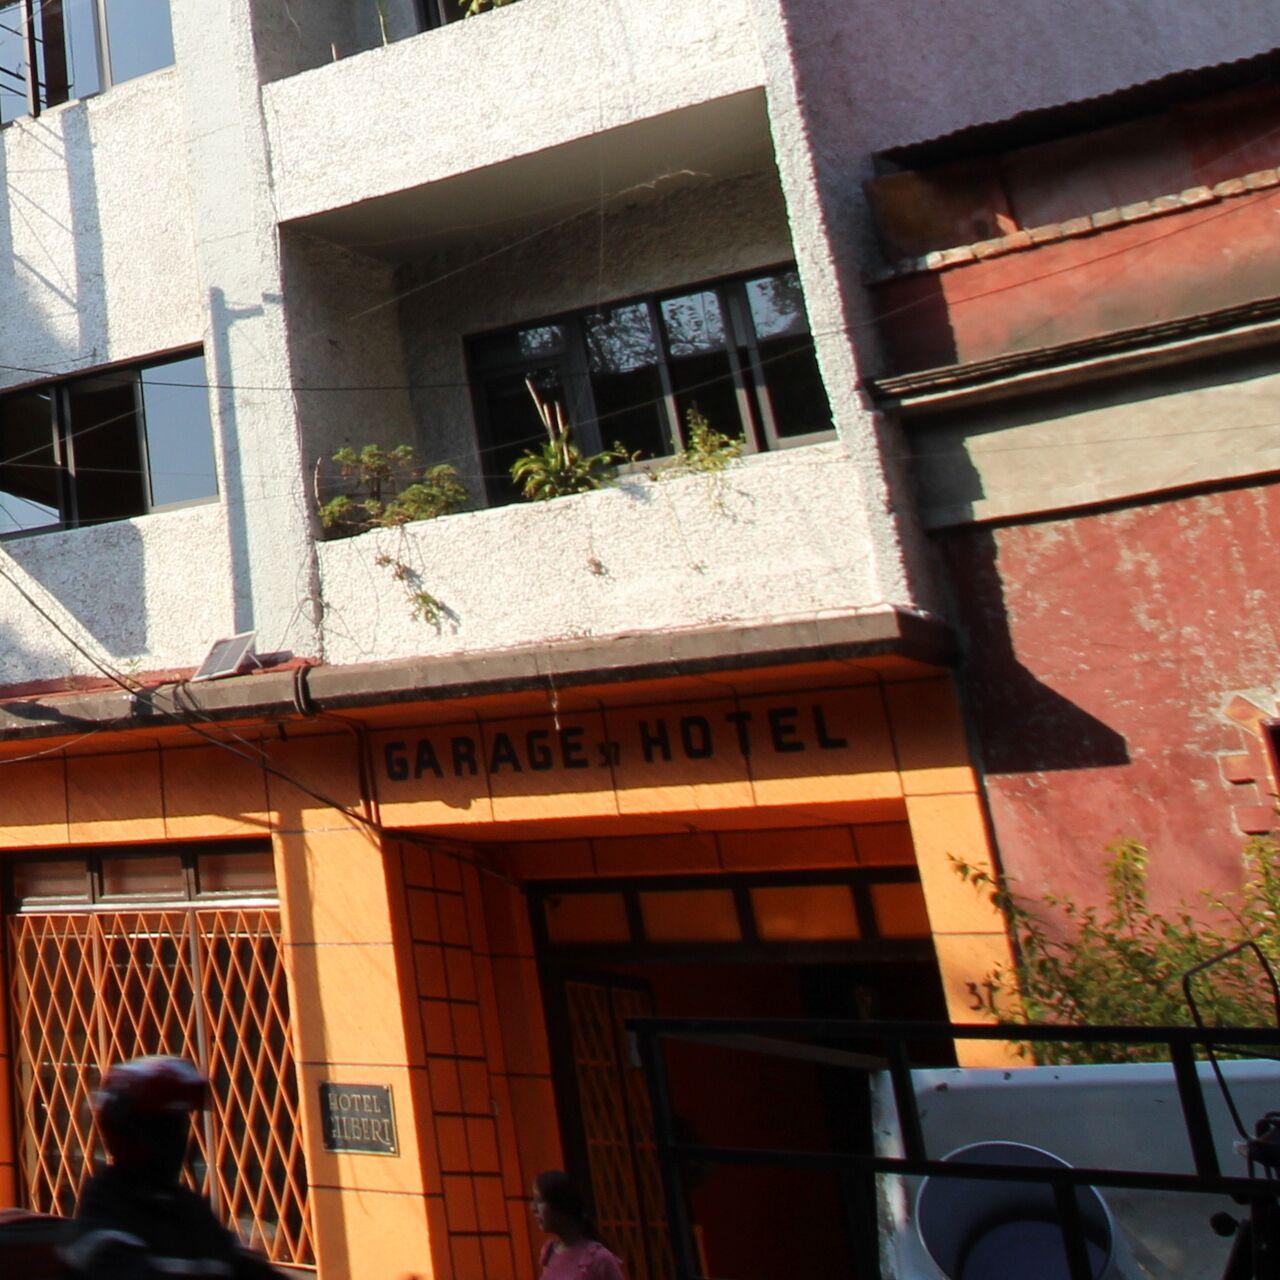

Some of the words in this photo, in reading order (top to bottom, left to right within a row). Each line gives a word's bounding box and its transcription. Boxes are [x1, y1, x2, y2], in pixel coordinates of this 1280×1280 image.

[383, 726, 589, 781] GARAGE
[641, 703, 849, 764] HOTEL
[328, 1092, 382, 1113] HOTEL
